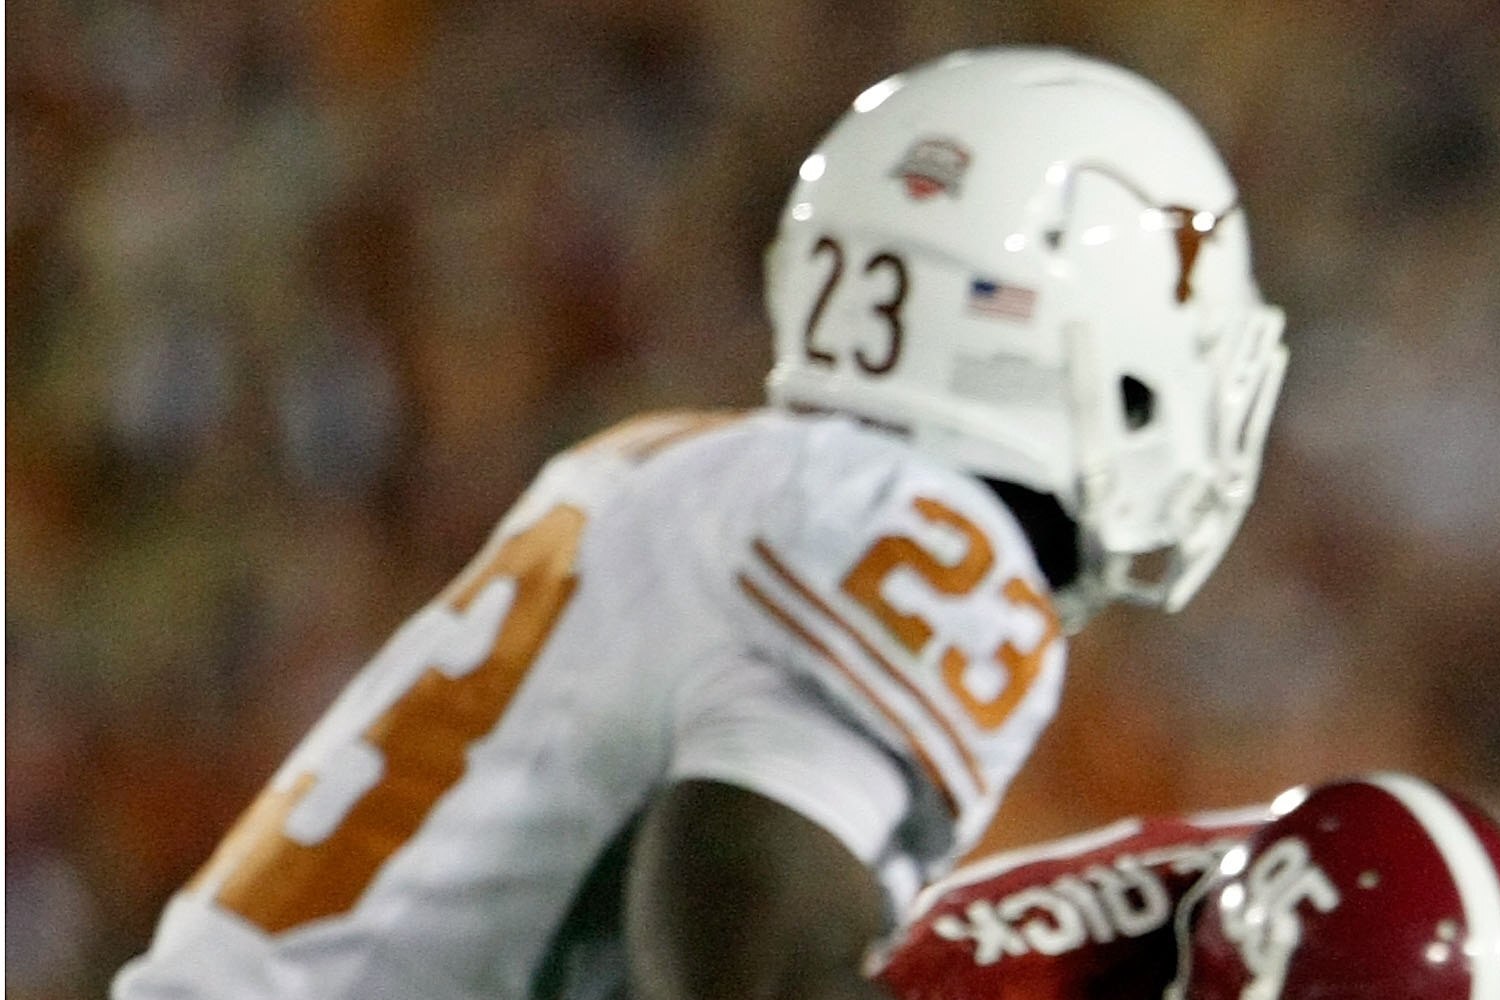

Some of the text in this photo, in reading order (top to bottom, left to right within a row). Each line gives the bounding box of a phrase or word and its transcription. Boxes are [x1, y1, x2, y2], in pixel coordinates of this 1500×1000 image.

[804, 234, 909, 376] 23
[188, 502, 587, 938] 3
[840, 496, 1060, 734] 23
